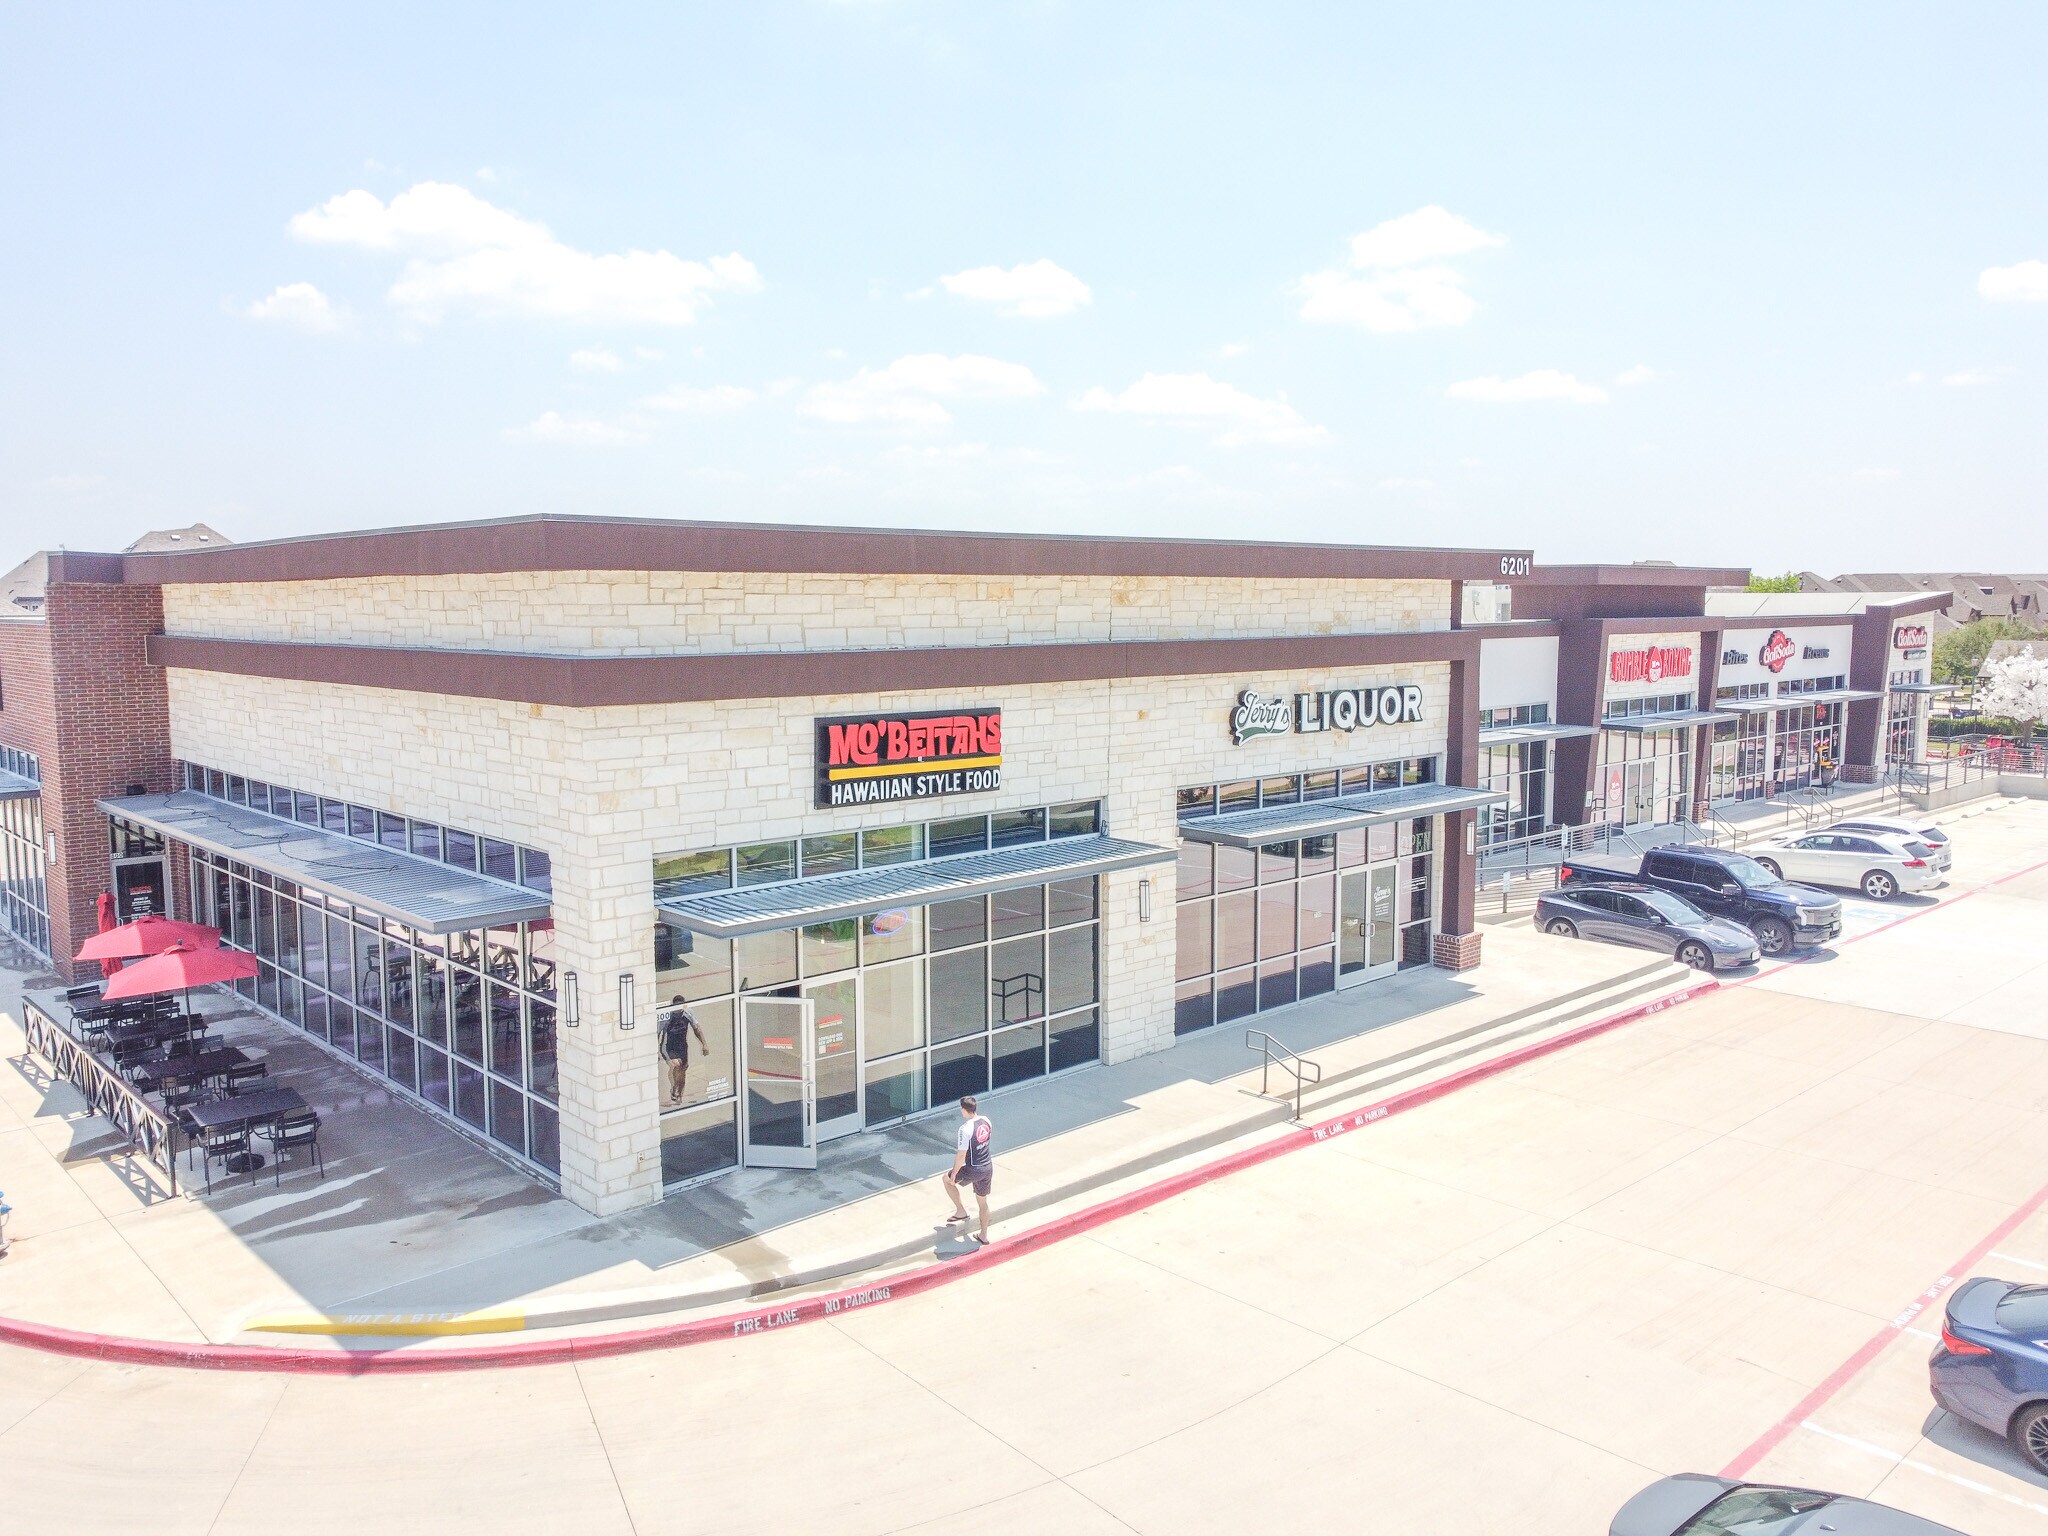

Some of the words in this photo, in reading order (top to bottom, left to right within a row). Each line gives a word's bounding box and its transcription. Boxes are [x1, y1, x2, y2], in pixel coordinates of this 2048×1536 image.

[1500, 557, 1530, 576] 6201
[1611, 651, 1649, 682] RUMBLE
[1660, 647, 1692, 678] BOXING
[1236, 690, 1291, 734] Jerry's
[1297, 686, 1423, 733] LIQUOR
[829, 714, 1002, 765] MO'BETTAHS
[831, 783, 912, 805] HAWAIIAN
[917, 772, 961, 796] STYLE
[966, 769, 1001, 791] FOOD
[1313, 1129, 1328, 1141] FIRE
[1328, 1122, 1345, 1136] LANE
[1354, 1115, 1364, 1126] NO
[1364, 1106, 1389, 1122] PARKING
[345, 1314, 383, 1324] NOT
[390, 1314, 403, 1323] A
[733, 1317, 763, 1337] FIRE
[767, 1309, 800, 1328] LANE
[825, 1299, 840, 1314] NO
[844, 1286, 891, 1309] PARKING
